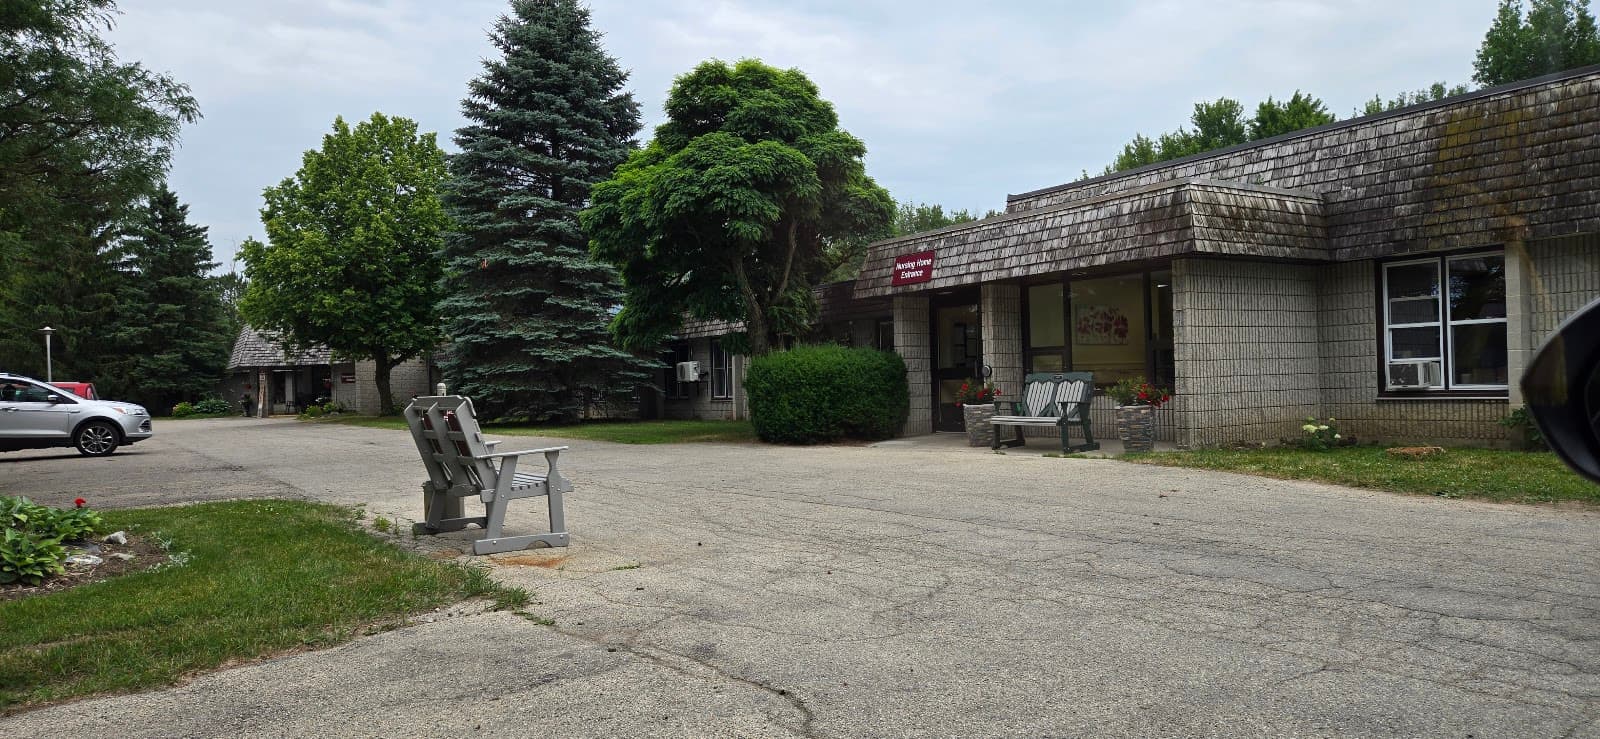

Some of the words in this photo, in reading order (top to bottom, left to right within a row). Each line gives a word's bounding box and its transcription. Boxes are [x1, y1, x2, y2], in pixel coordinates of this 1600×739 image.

[896, 261, 915, 270] Nursing
[917, 258, 932, 267] Home
[901, 270, 923, 279] Entrance
